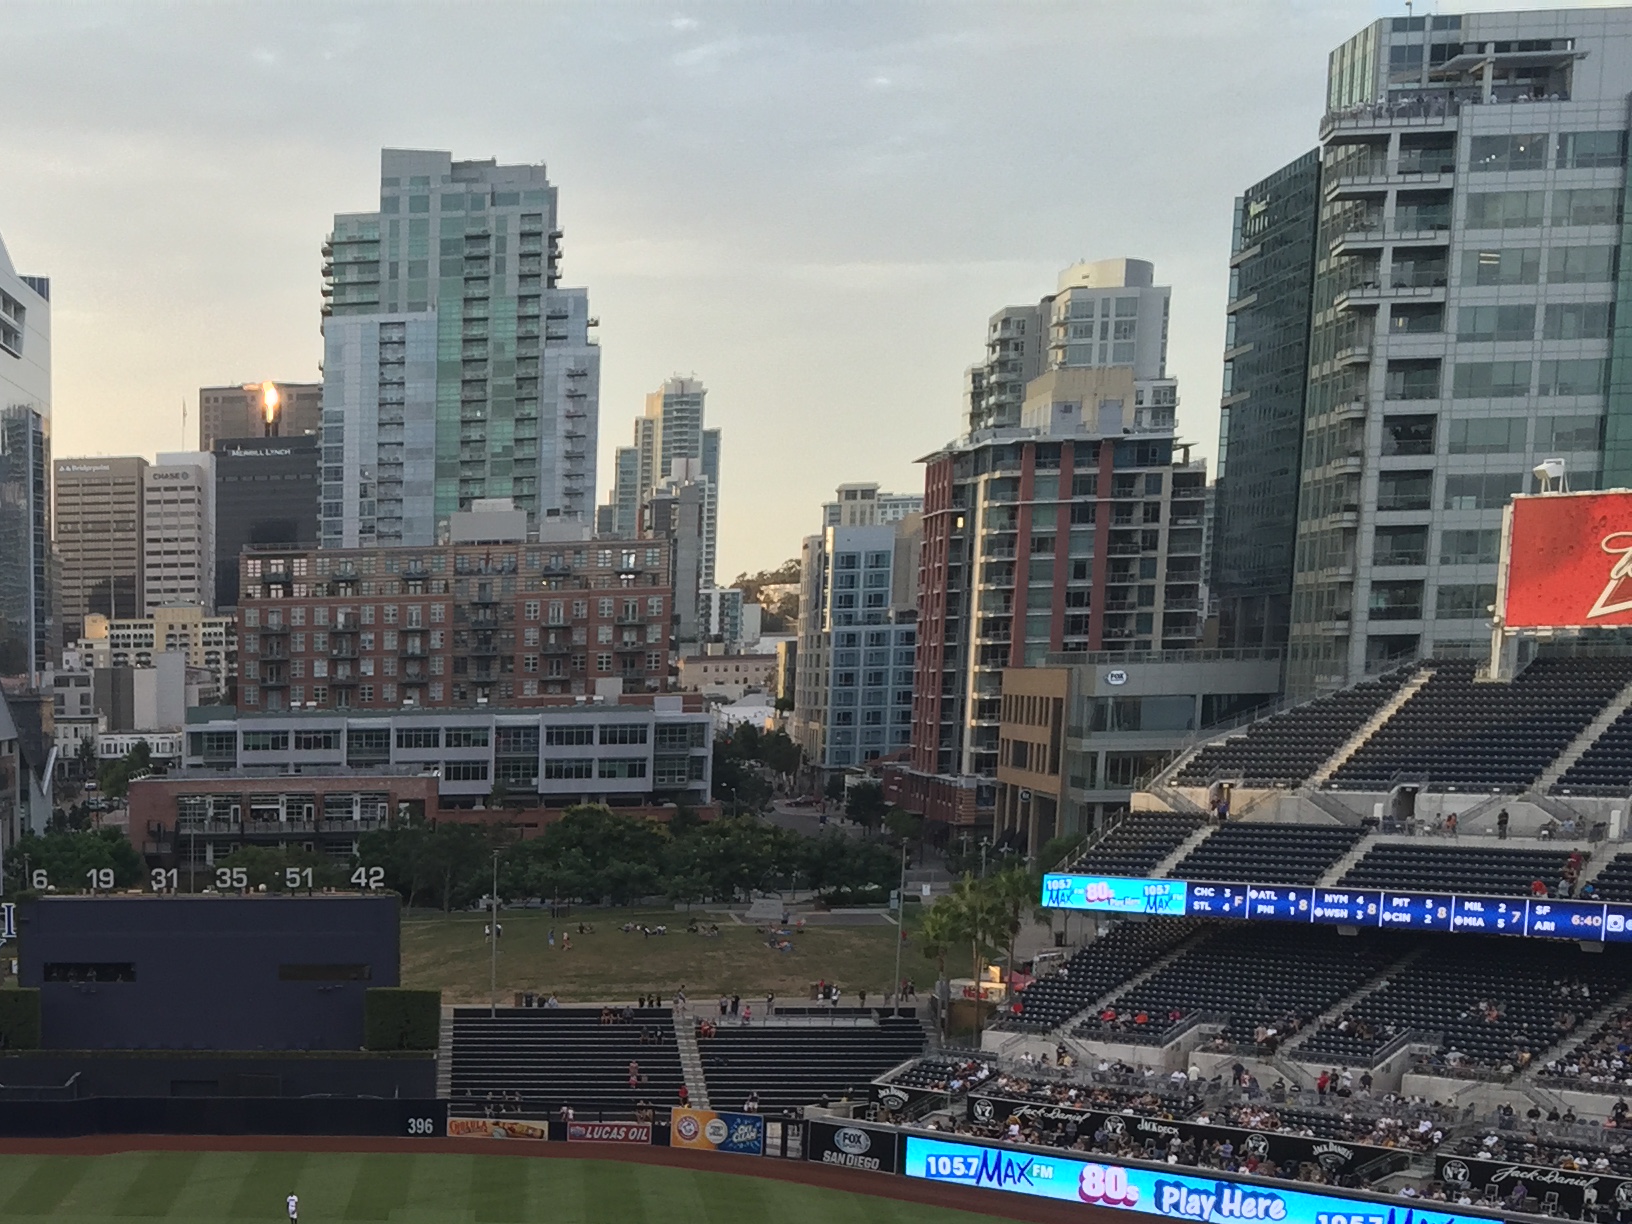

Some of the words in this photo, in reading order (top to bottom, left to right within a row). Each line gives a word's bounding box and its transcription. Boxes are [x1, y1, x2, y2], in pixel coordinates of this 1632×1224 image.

[32, 869, 48, 889] 6
[86, 868, 115, 889] 19
[151, 868, 179, 888] 31
[215, 868, 248, 888] 35
[285, 868, 313, 888] 51
[350, 867, 385, 888] 42
[1194, 887, 1215, 897] CHC
[1258, 890, 1277, 900] ATL
[1047, 889, 1073, 907] MAX
[1324, 893, 1348, 903] NYM
[1392, 897, 1410, 907] PIT
[1144, 895, 1172, 913] MAX
[1193, 900, 1211, 911] STL
[1257, 904, 1274, 914] PHI
[1464, 901, 1484, 911] MIL
[1324, 908, 1348, 918] WSN
[1536, 905, 1550, 915] SF
[1391, 912, 1411, 923] CIN
[1463, 916, 1485, 927] MIA
[1571, 915, 1602, 927] 6:40
[1534, 921, 1555, 931] ARI
[1013, 1105, 1043, 1117] Jack
[407, 1117, 433, 1135] 396
[1158, 1124, 1179, 1135] DECK
[586, 1126, 626, 1139] LUCAS
[628, 1127, 649, 1141] OIL
[843, 1132, 863, 1144] FOX
[822, 1150, 846, 1165] SAN
[846, 1154, 880, 1170] DIEGO
[976, 1150, 1034, 1187] MAX
[1032, 1164, 1054, 1179] FM
[1491, 1165, 1538, 1183] Jack
[1538, 1169, 1600, 1190] Daniel
[1080, 1163, 1140, 1204] 80s
[1161, 1186, 1216, 1221] Play
[1221, 1188, 1287, 1220] Here
